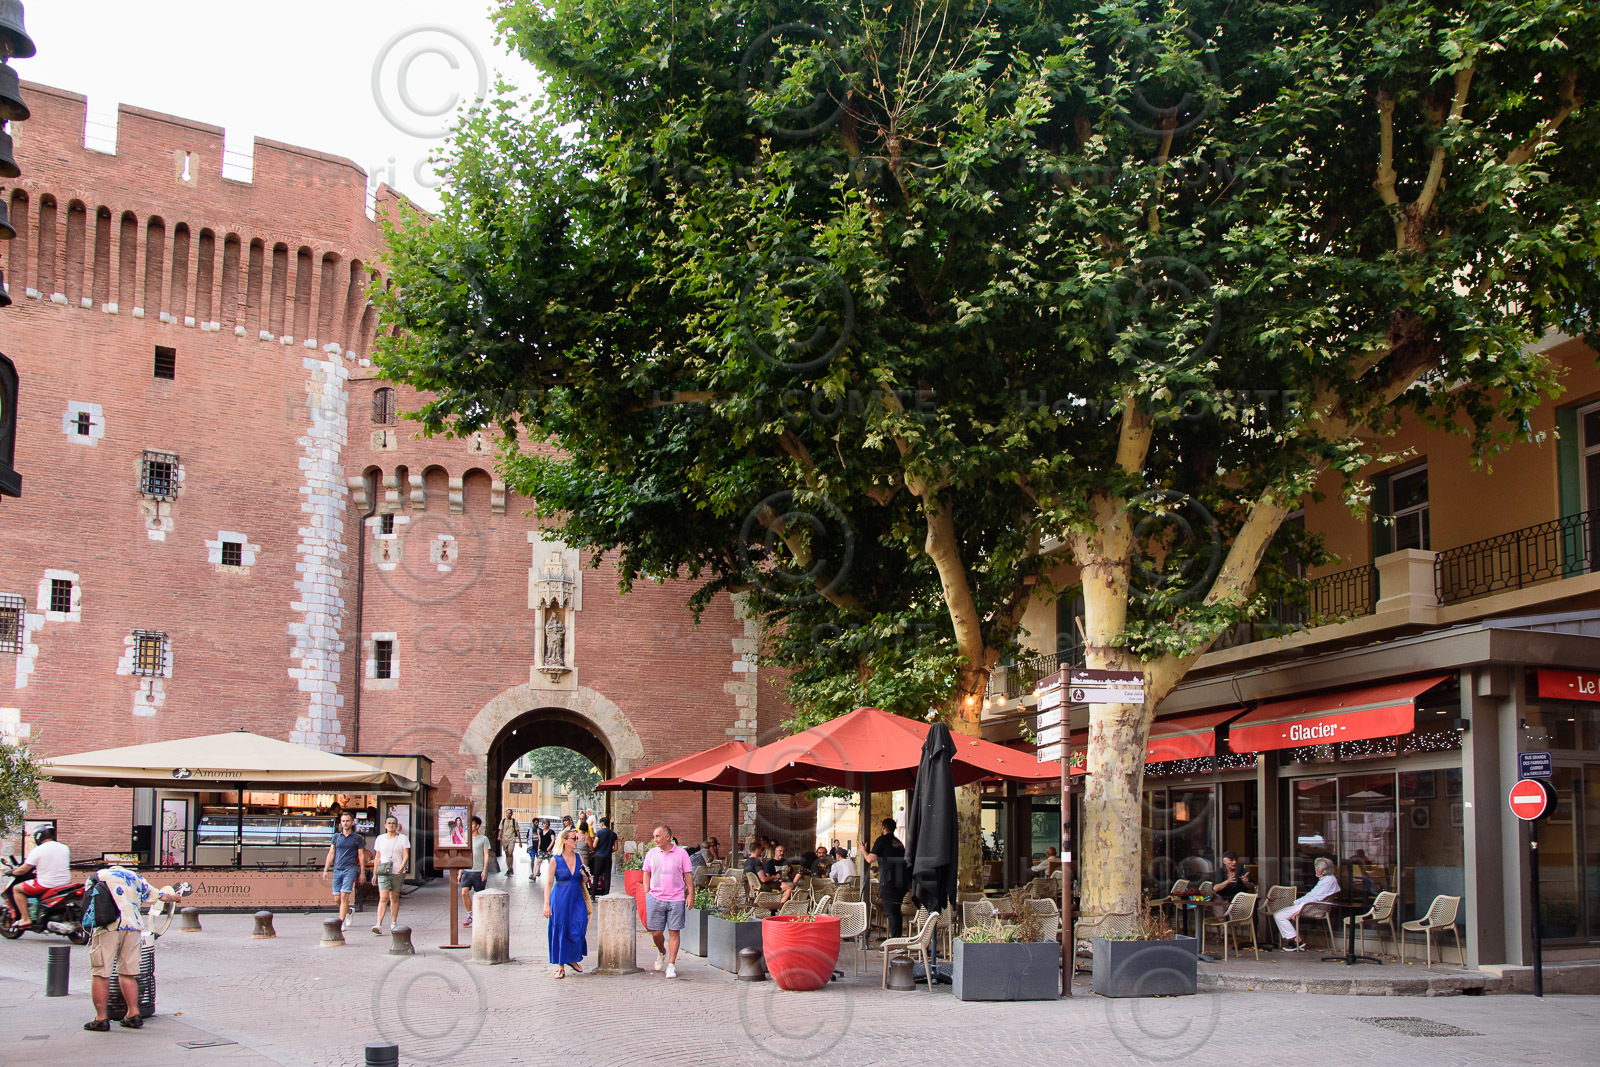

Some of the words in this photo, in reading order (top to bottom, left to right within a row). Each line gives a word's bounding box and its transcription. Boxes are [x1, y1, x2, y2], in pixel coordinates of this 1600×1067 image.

[1577, 675, 1596, 694] Le
[1289, 722, 1338, 741] Glacier
[193, 767, 242, 778] Amorino
[195, 881, 251, 894] Amorino
